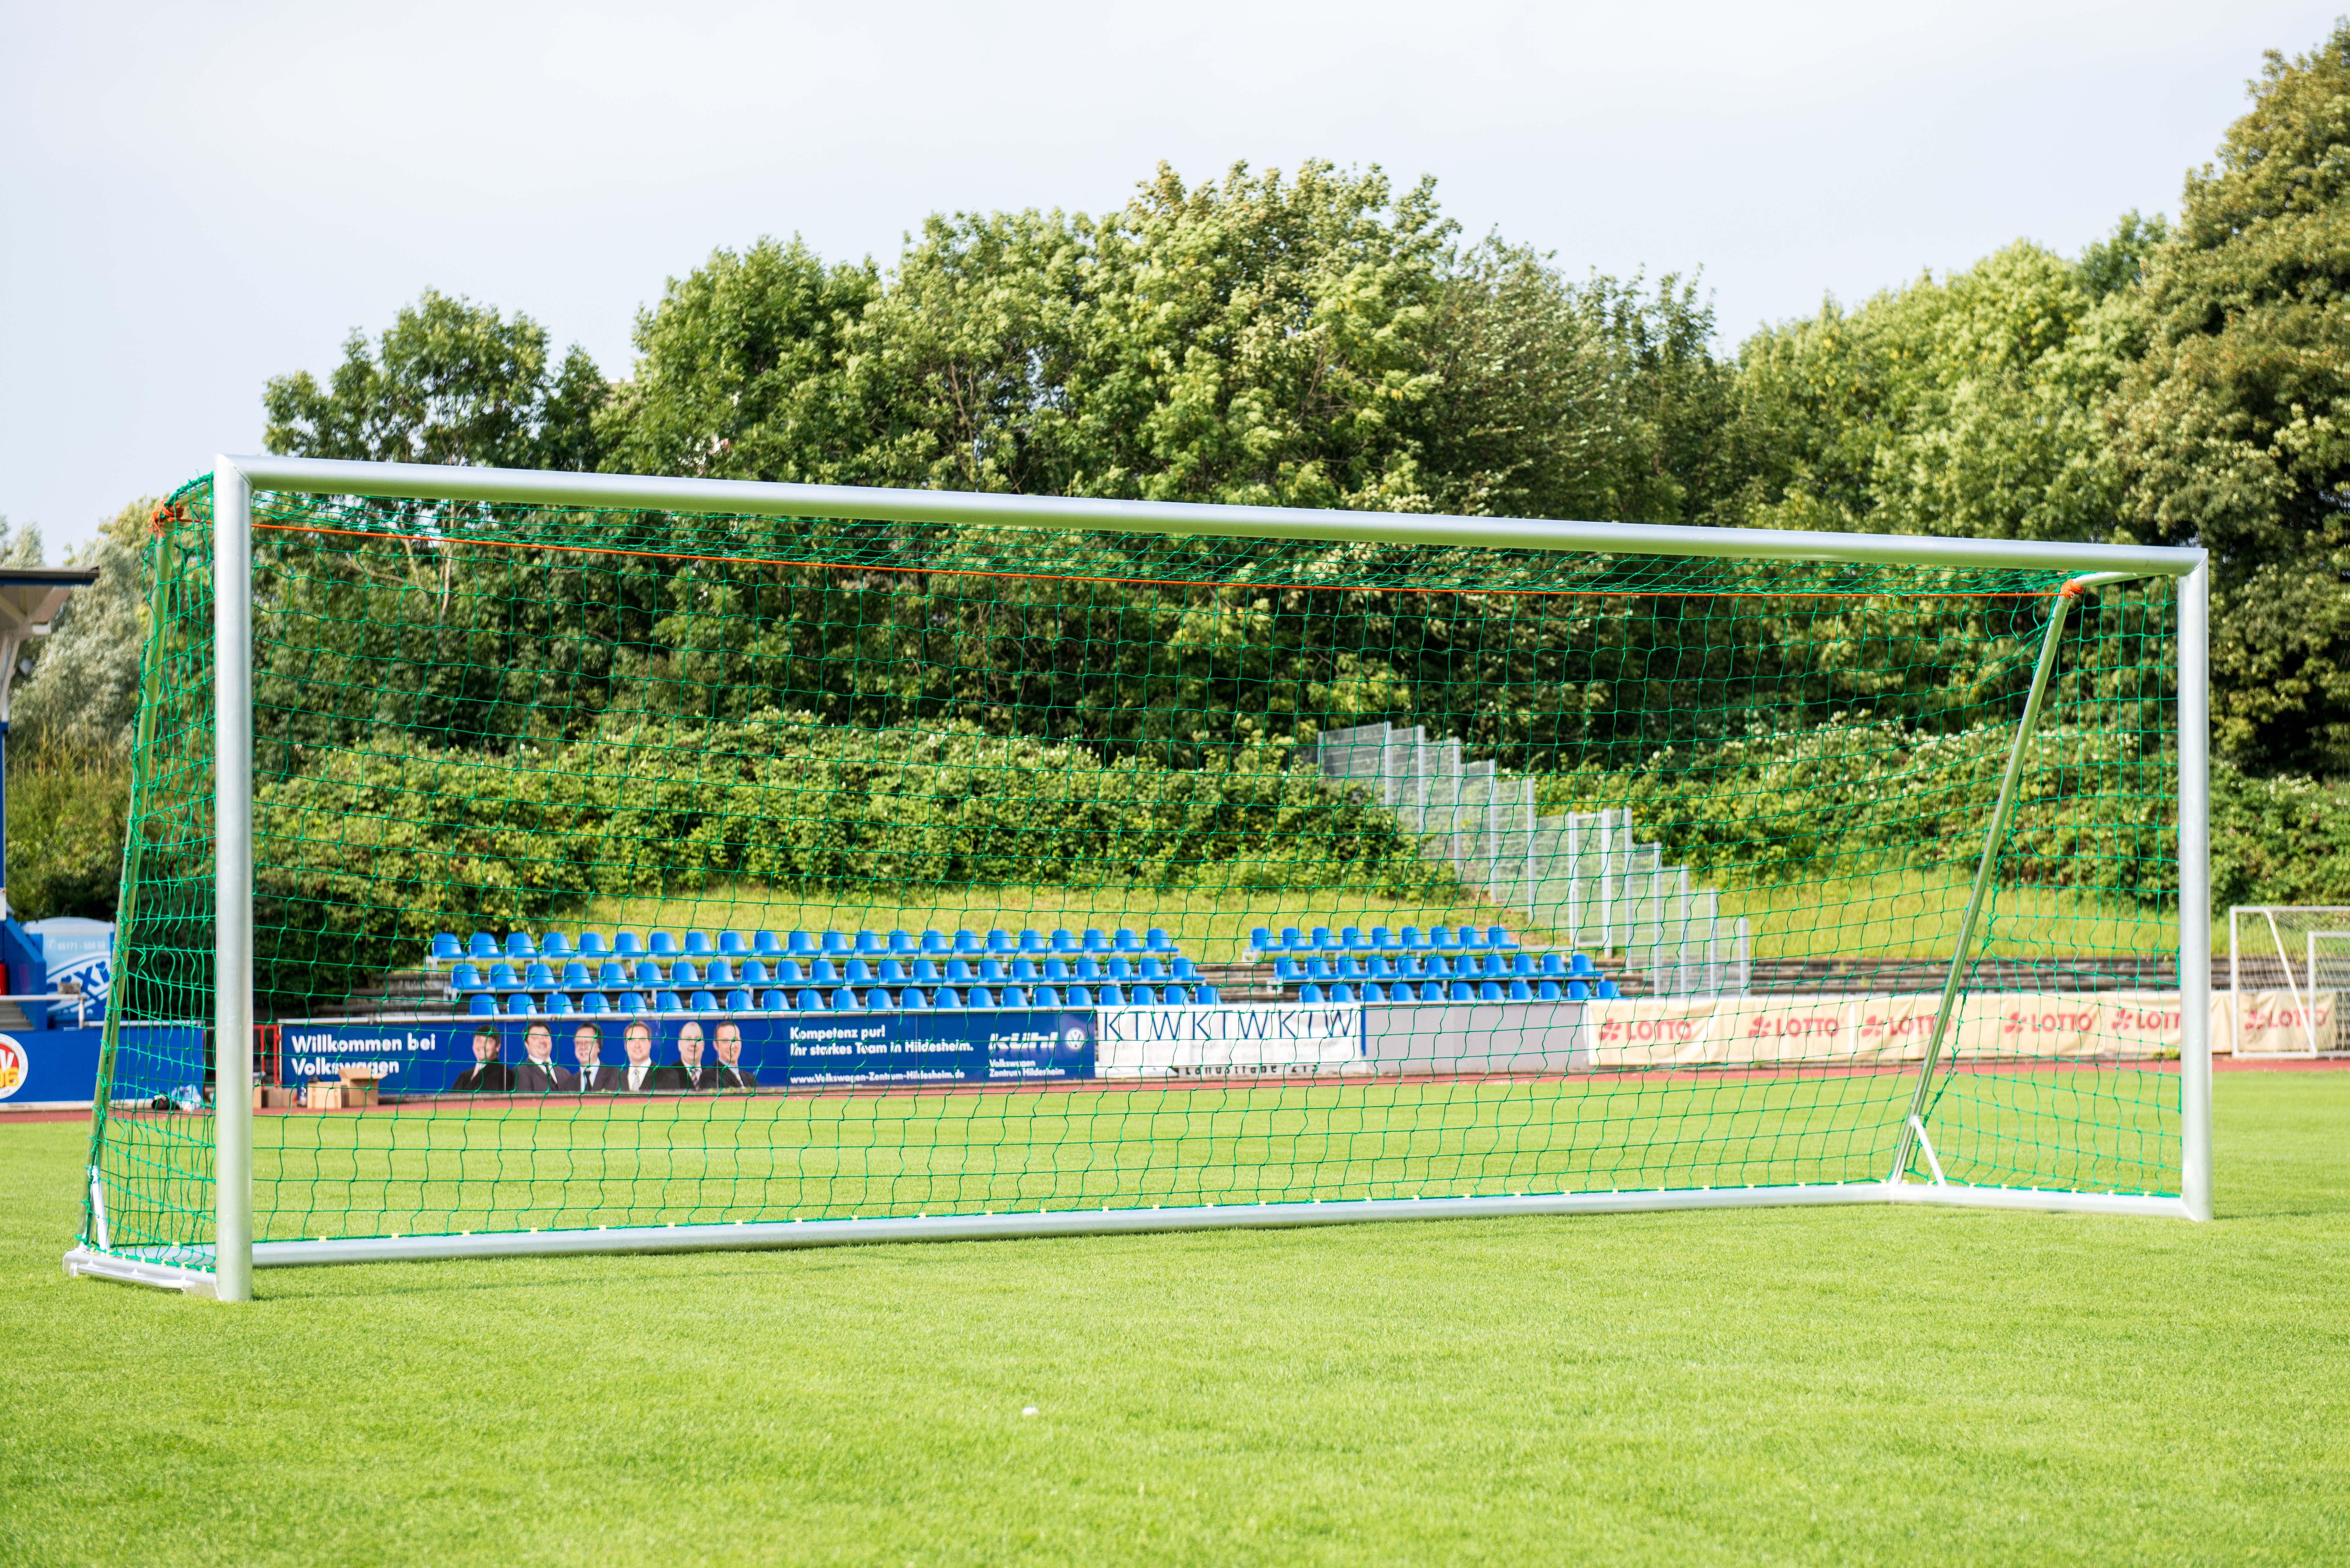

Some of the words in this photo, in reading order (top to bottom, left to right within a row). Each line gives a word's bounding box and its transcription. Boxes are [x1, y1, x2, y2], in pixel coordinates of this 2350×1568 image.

[1105, 1011, 1182, 1040] KTW
[1193, 1010, 1269, 1039] KTW
[1627, 1020, 1691, 1040] LOTTO
[1777, 1018, 1839, 1037] LOTTO
[2032, 1014, 2091, 1032] LOTTO
[790, 1027, 858, 1041] Kompetenz
[861, 1024, 885, 1040] pur!
[291, 1034, 402, 1053] Willkommen
[407, 1032, 435, 1051] bei
[790, 1043, 807, 1056] Ihr
[810, 1042, 852, 1055] starkes
[855, 1042, 887, 1054] Team
[890, 1040, 902, 1053] in
[905, 1039, 974, 1053] Hildesheim.
[989, 1058, 1036, 1067] Volkswagen
[790, 1069, 965, 1084] www.Volkswagen-Zentrum-Hildesheim.de
[989, 1068, 1021, 1077] Zentrum
[1023, 1067, 1065, 1077] Hildesheim
